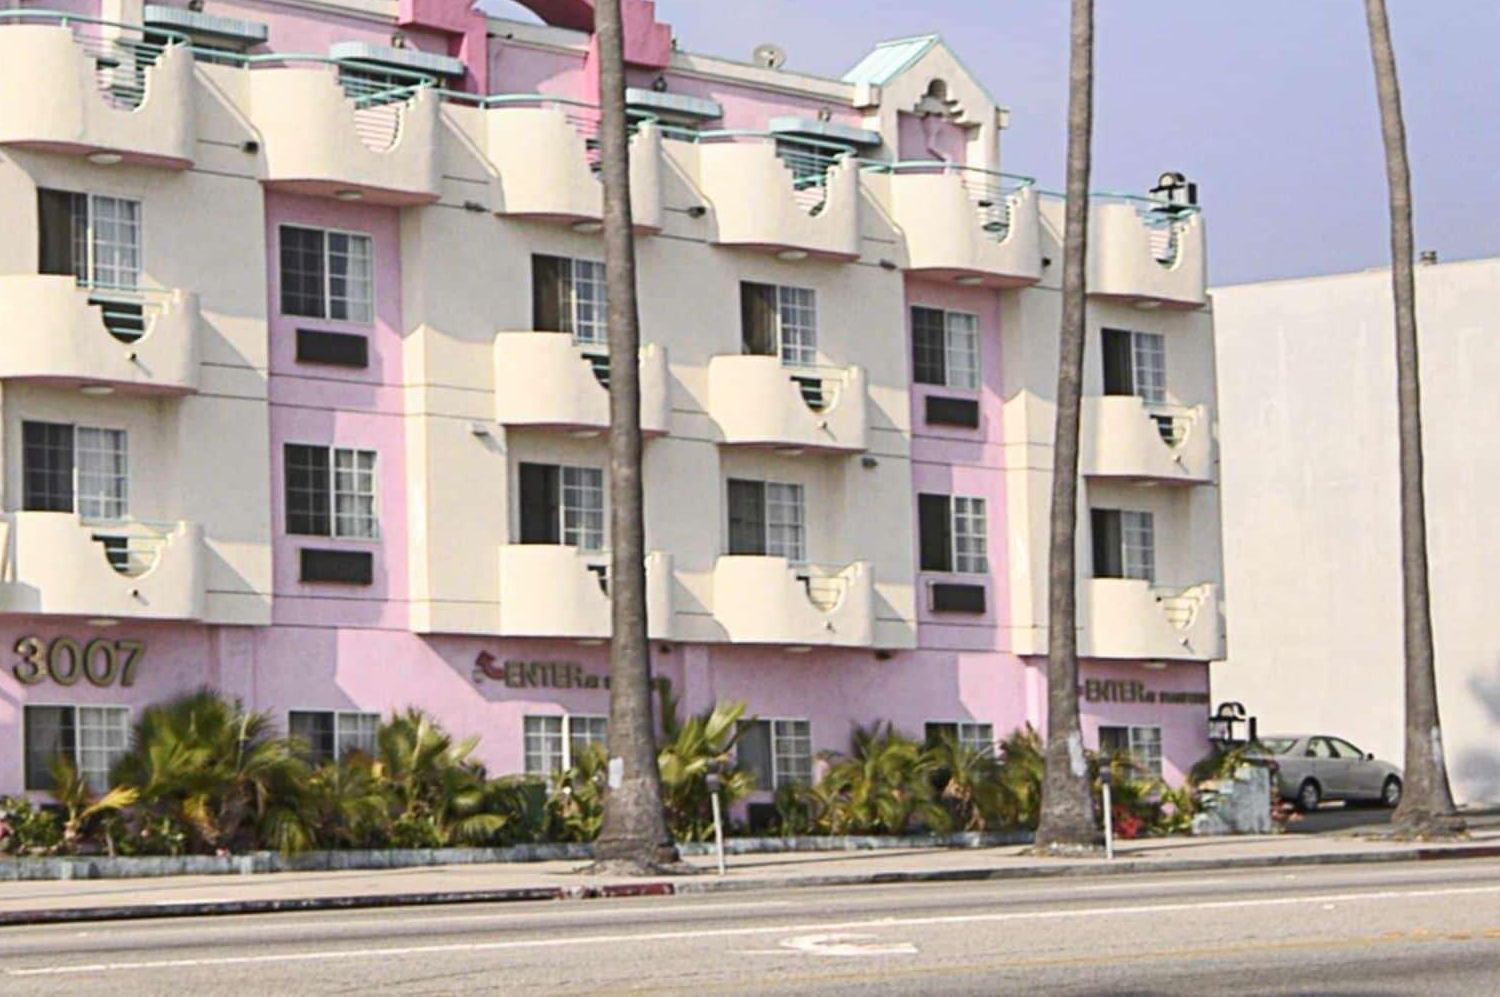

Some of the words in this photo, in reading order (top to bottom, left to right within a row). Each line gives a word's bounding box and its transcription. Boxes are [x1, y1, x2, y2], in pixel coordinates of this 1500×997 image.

[11, 634, 147, 688] 3007
[504, 659, 583, 689] ENTER
[1084, 679, 1146, 702] ENTER
